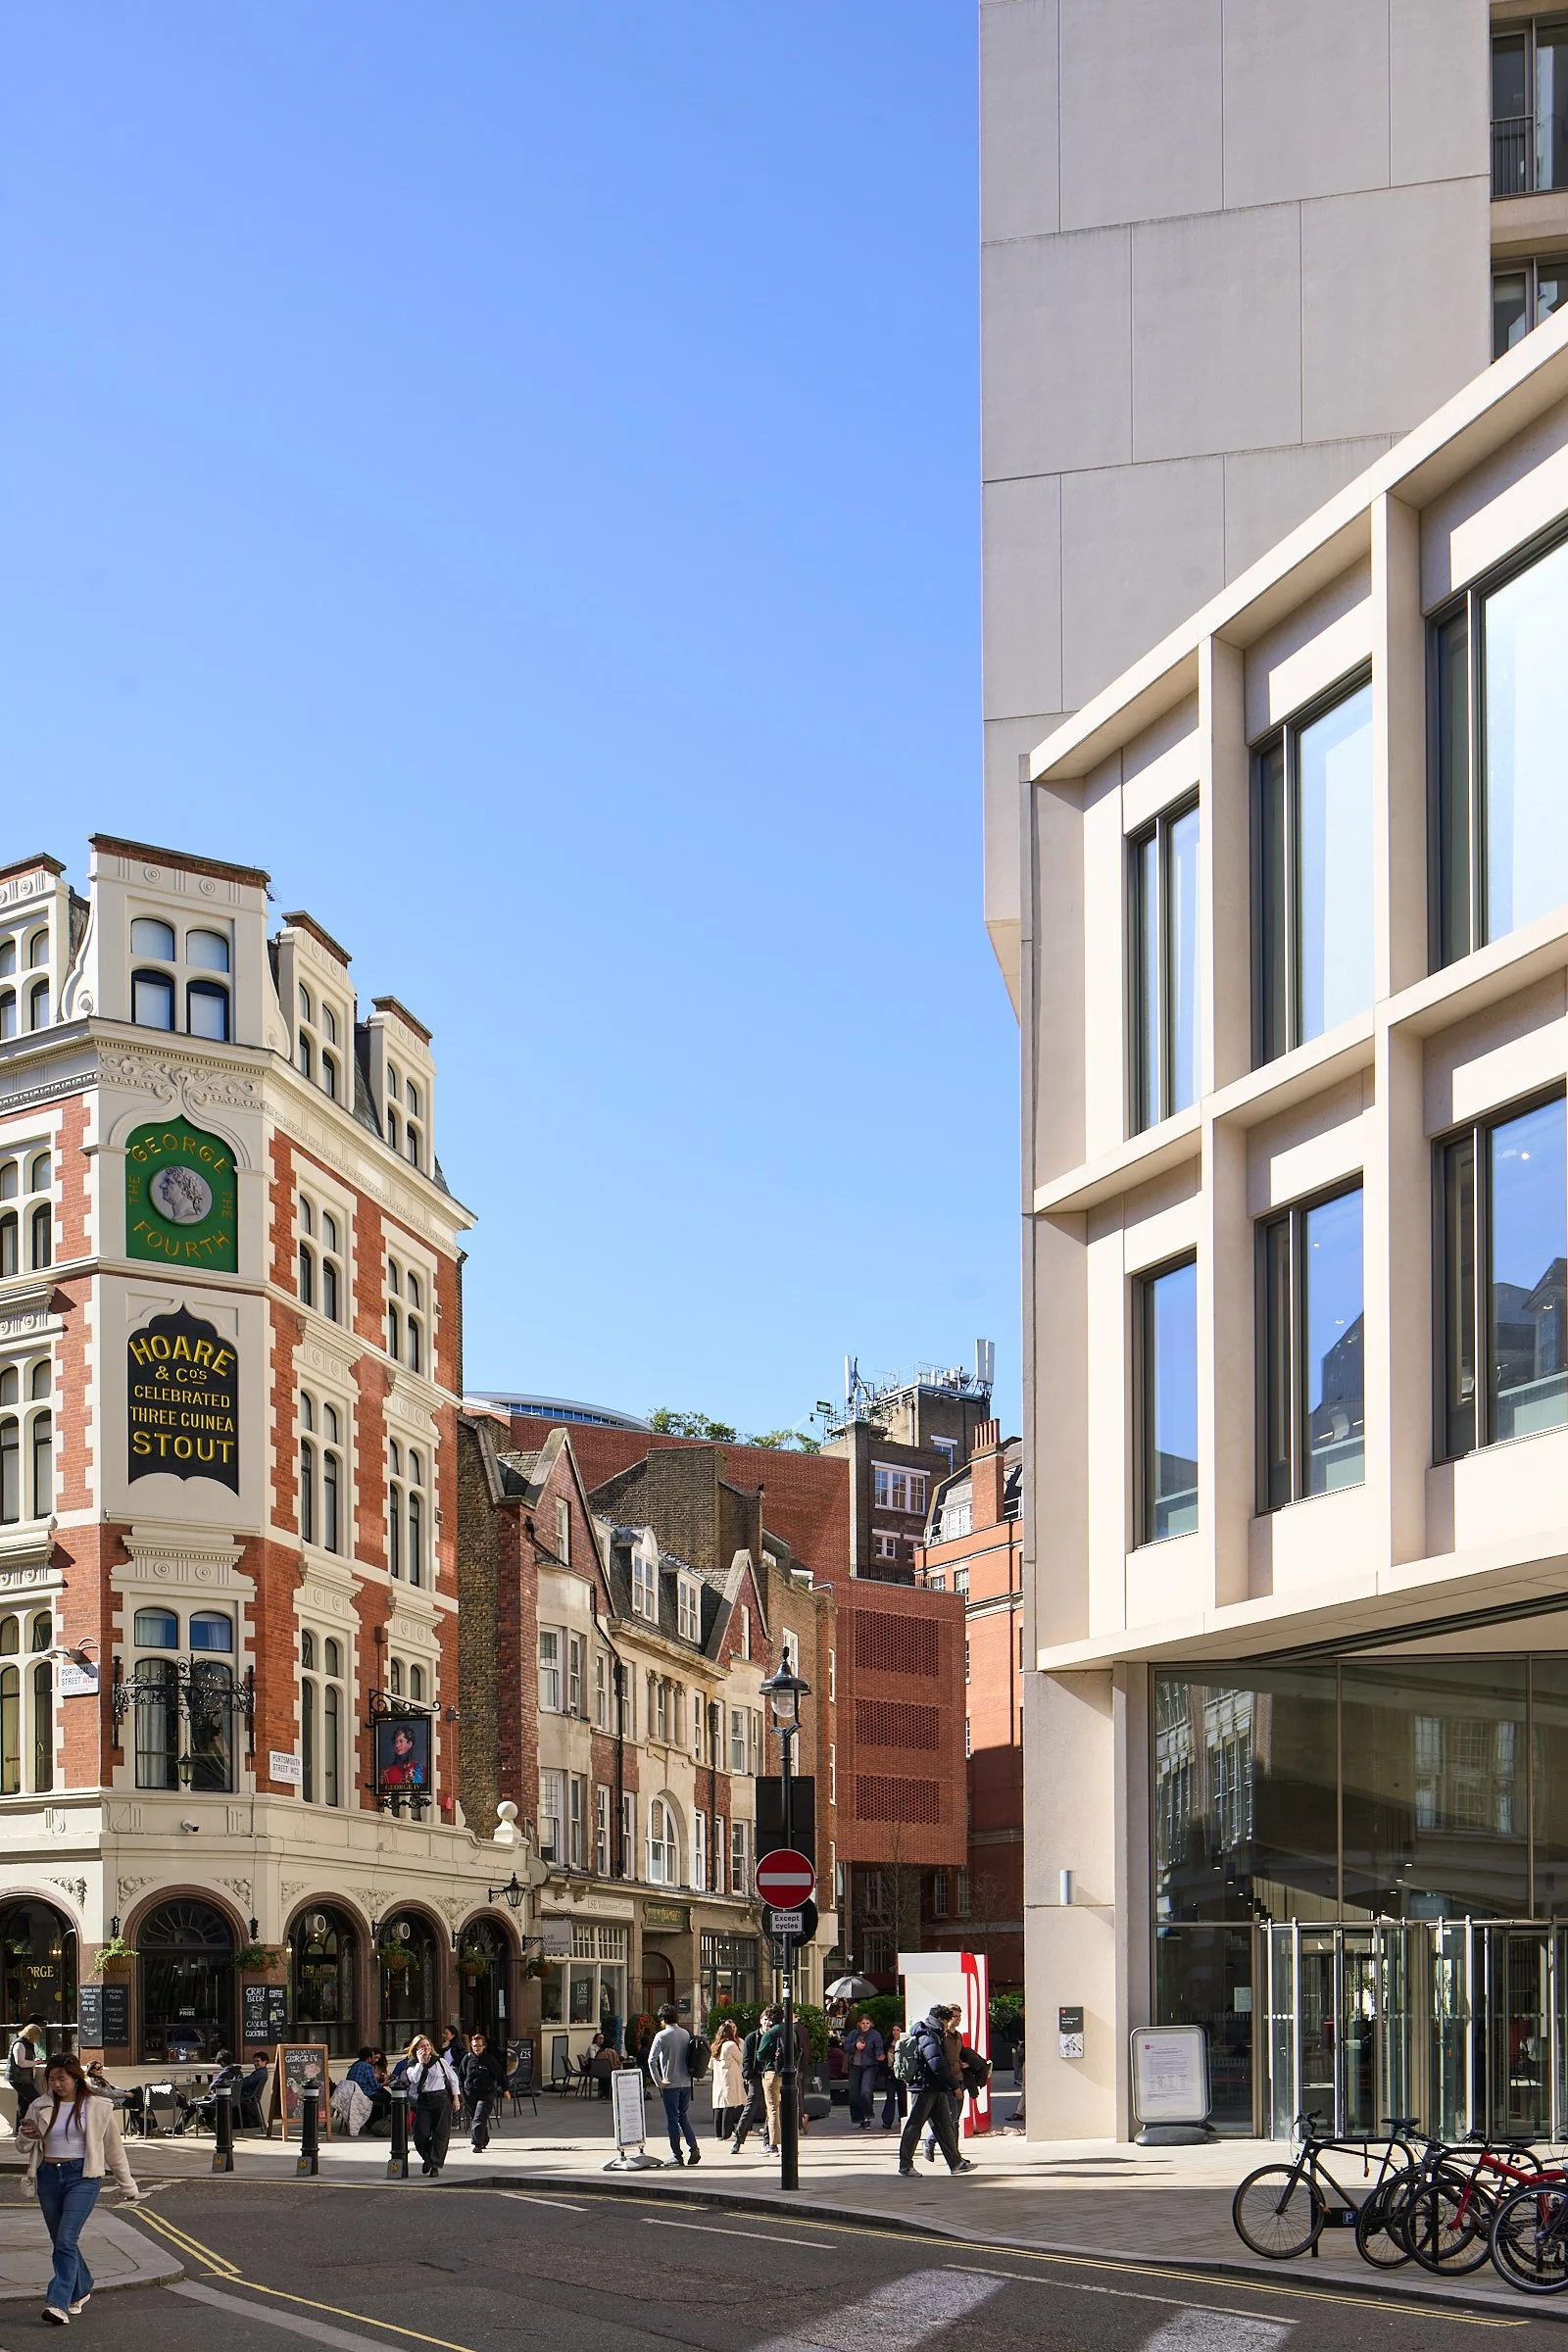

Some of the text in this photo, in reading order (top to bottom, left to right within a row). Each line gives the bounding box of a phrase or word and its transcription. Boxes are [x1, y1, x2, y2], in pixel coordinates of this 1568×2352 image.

[131, 1133, 230, 1174] GEORGE
[128, 1176, 141, 1203] THE
[221, 1191, 234, 1219] THE
[133, 1220, 230, 1257] FOURTH
[128, 1334, 236, 1377] HOARE
[155, 1365, 171, 1381] &
[133, 1385, 230, 1408] CELEBRATED
[129, 1406, 178, 1426] THREE
[132, 1430, 235, 1463] STOUT
[62, 1676, 81, 1686] STREET
[272, 1754, 301, 1767] PORTSMOUTH
[272, 1763, 288, 1773] STREET
[587, 1898, 597, 1910] LSE
[246, 1986, 266, 1996] CRAFT
[269, 1989, 284, 1998] COFFEE
[519, 2050, 531, 2059] £25
[1346, 2213, 1353, 2223] P
